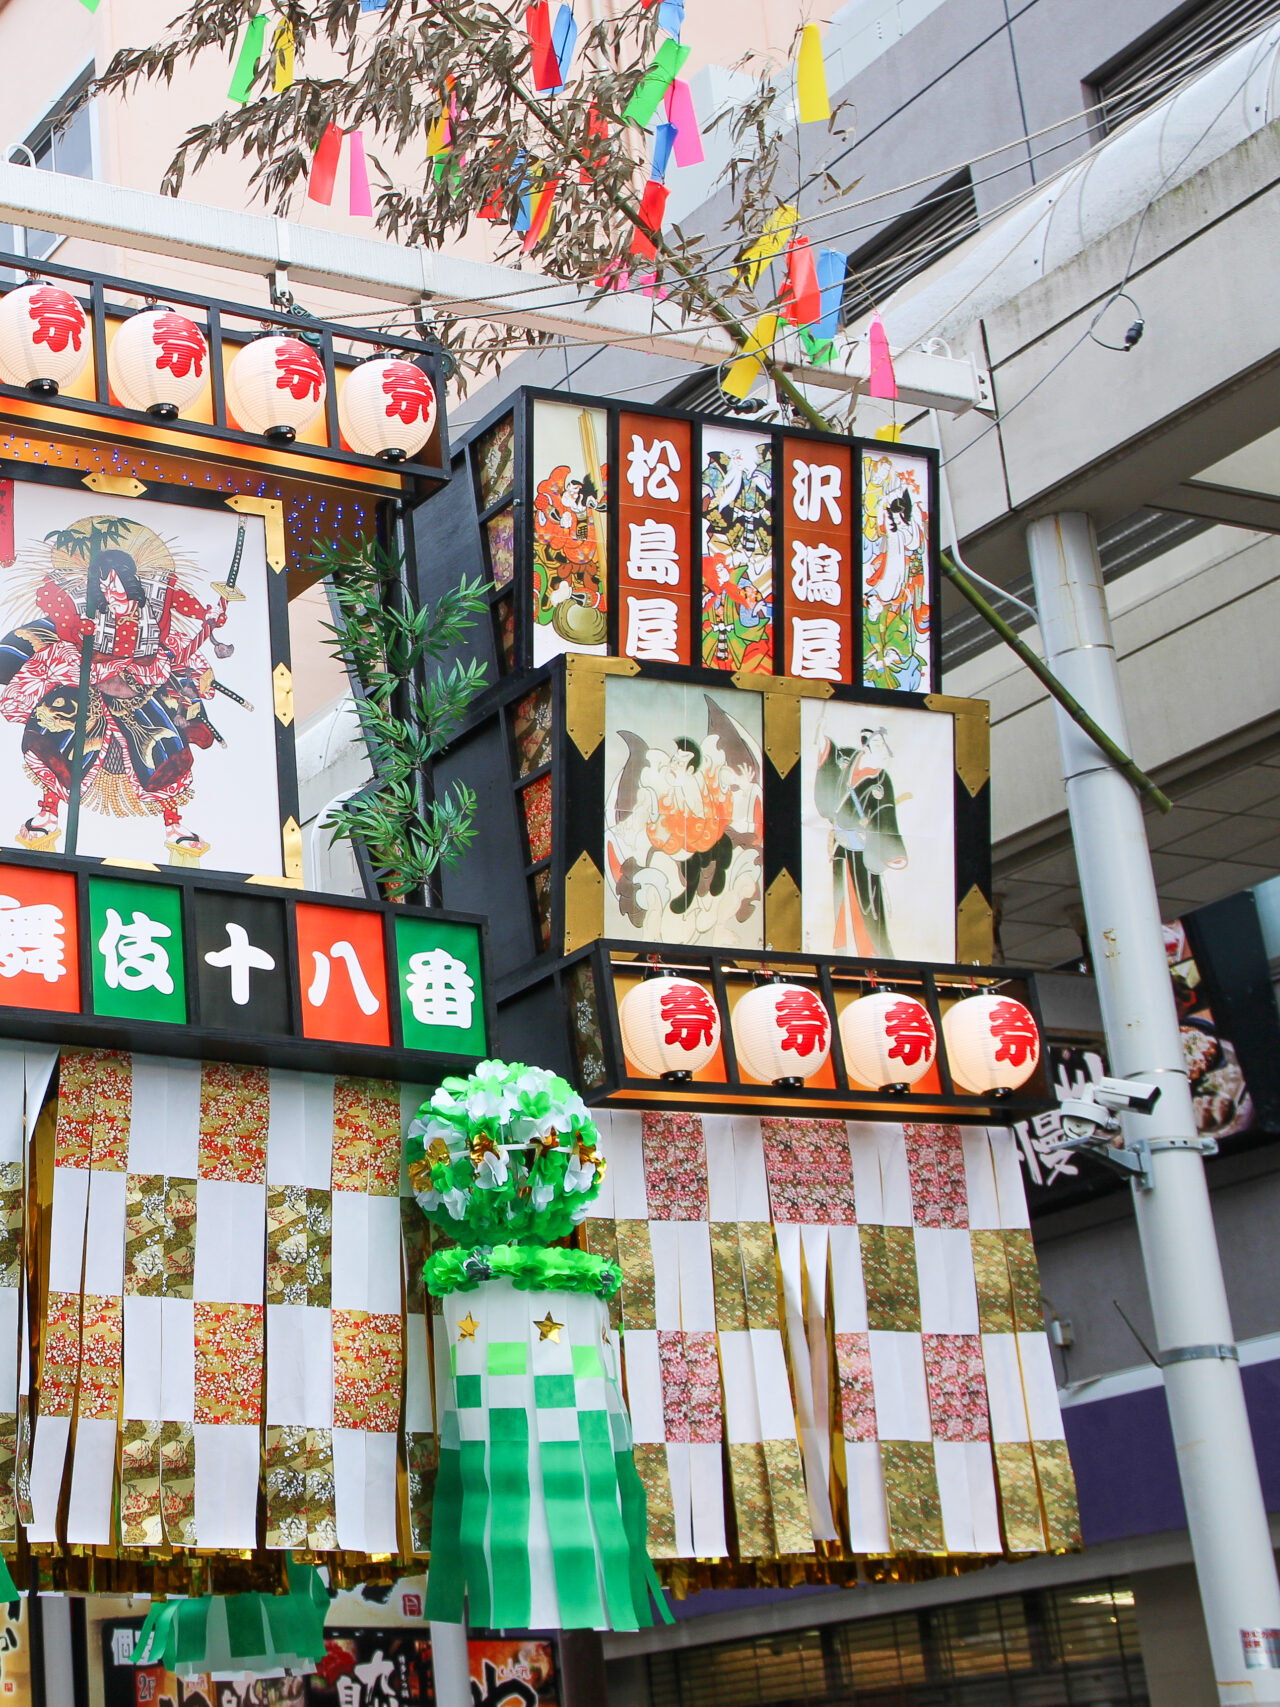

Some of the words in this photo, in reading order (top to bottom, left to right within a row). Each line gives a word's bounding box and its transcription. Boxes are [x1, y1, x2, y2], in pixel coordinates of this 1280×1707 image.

[29, 287, 85, 352] 祭
[153, 312, 207, 378] 祭
[275, 338, 325, 402] 祭
[382, 362, 433, 424] 祭
[625, 434, 681, 662] 松島屋
[791, 459, 842, 682] 沢瀉屋
[660, 984, 716, 1051] 祭
[776, 990, 831, 1058] 祭
[885, 1001, 936, 1066] 祭
[989, 1000, 1039, 1068] 祭
[137, 1674, 157, 1702] 2F
